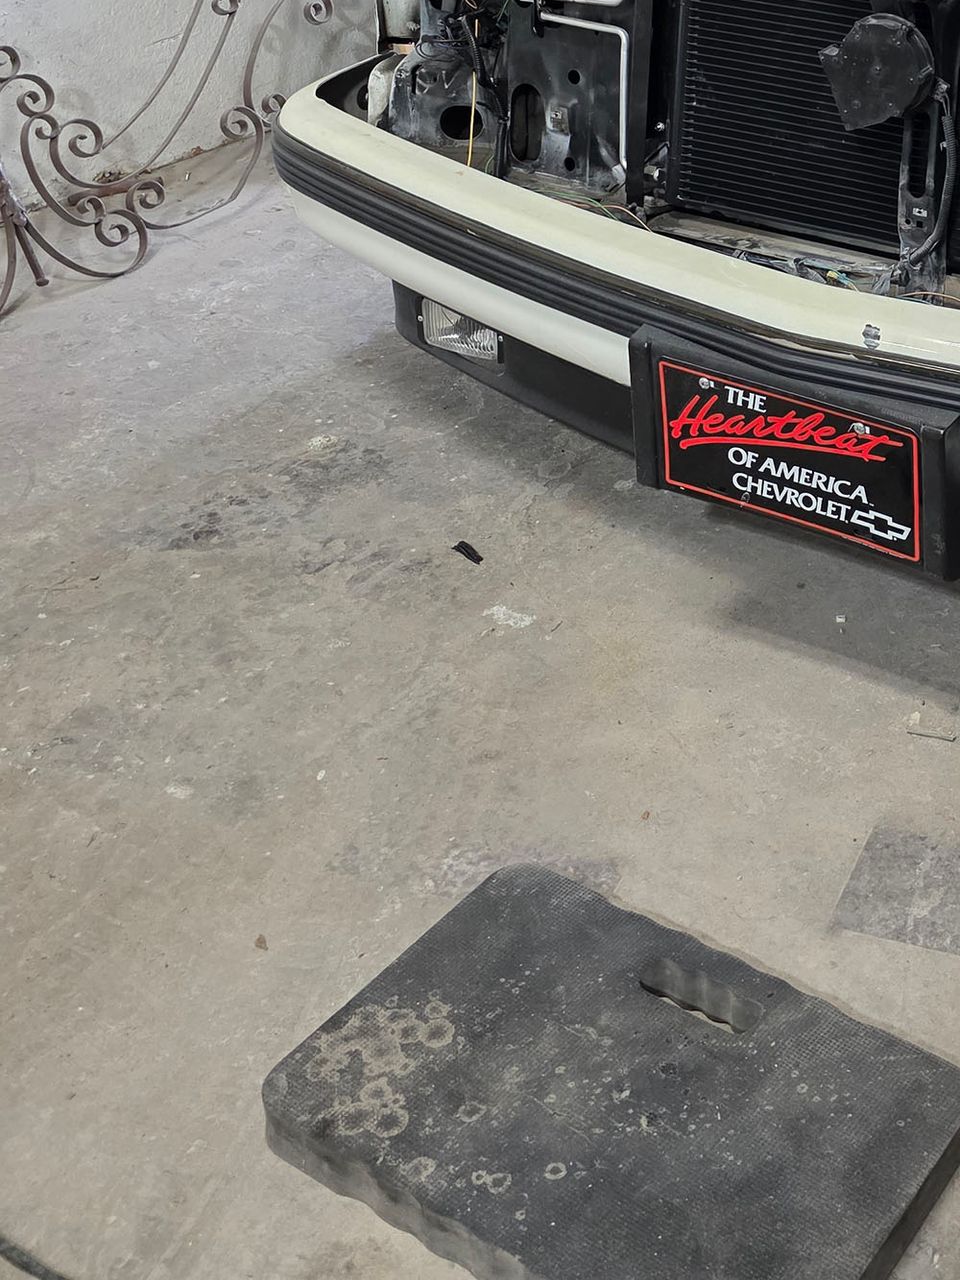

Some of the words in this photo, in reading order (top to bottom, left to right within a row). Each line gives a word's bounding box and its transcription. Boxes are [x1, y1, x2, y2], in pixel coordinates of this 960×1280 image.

[724, 385, 767, 413] THE
[669, 394, 904, 461] Heartbeat
[727, 446, 759, 472] OF
[757, 456, 869, 505] AMERICA
[731, 472, 851, 523] CHEVROLET
